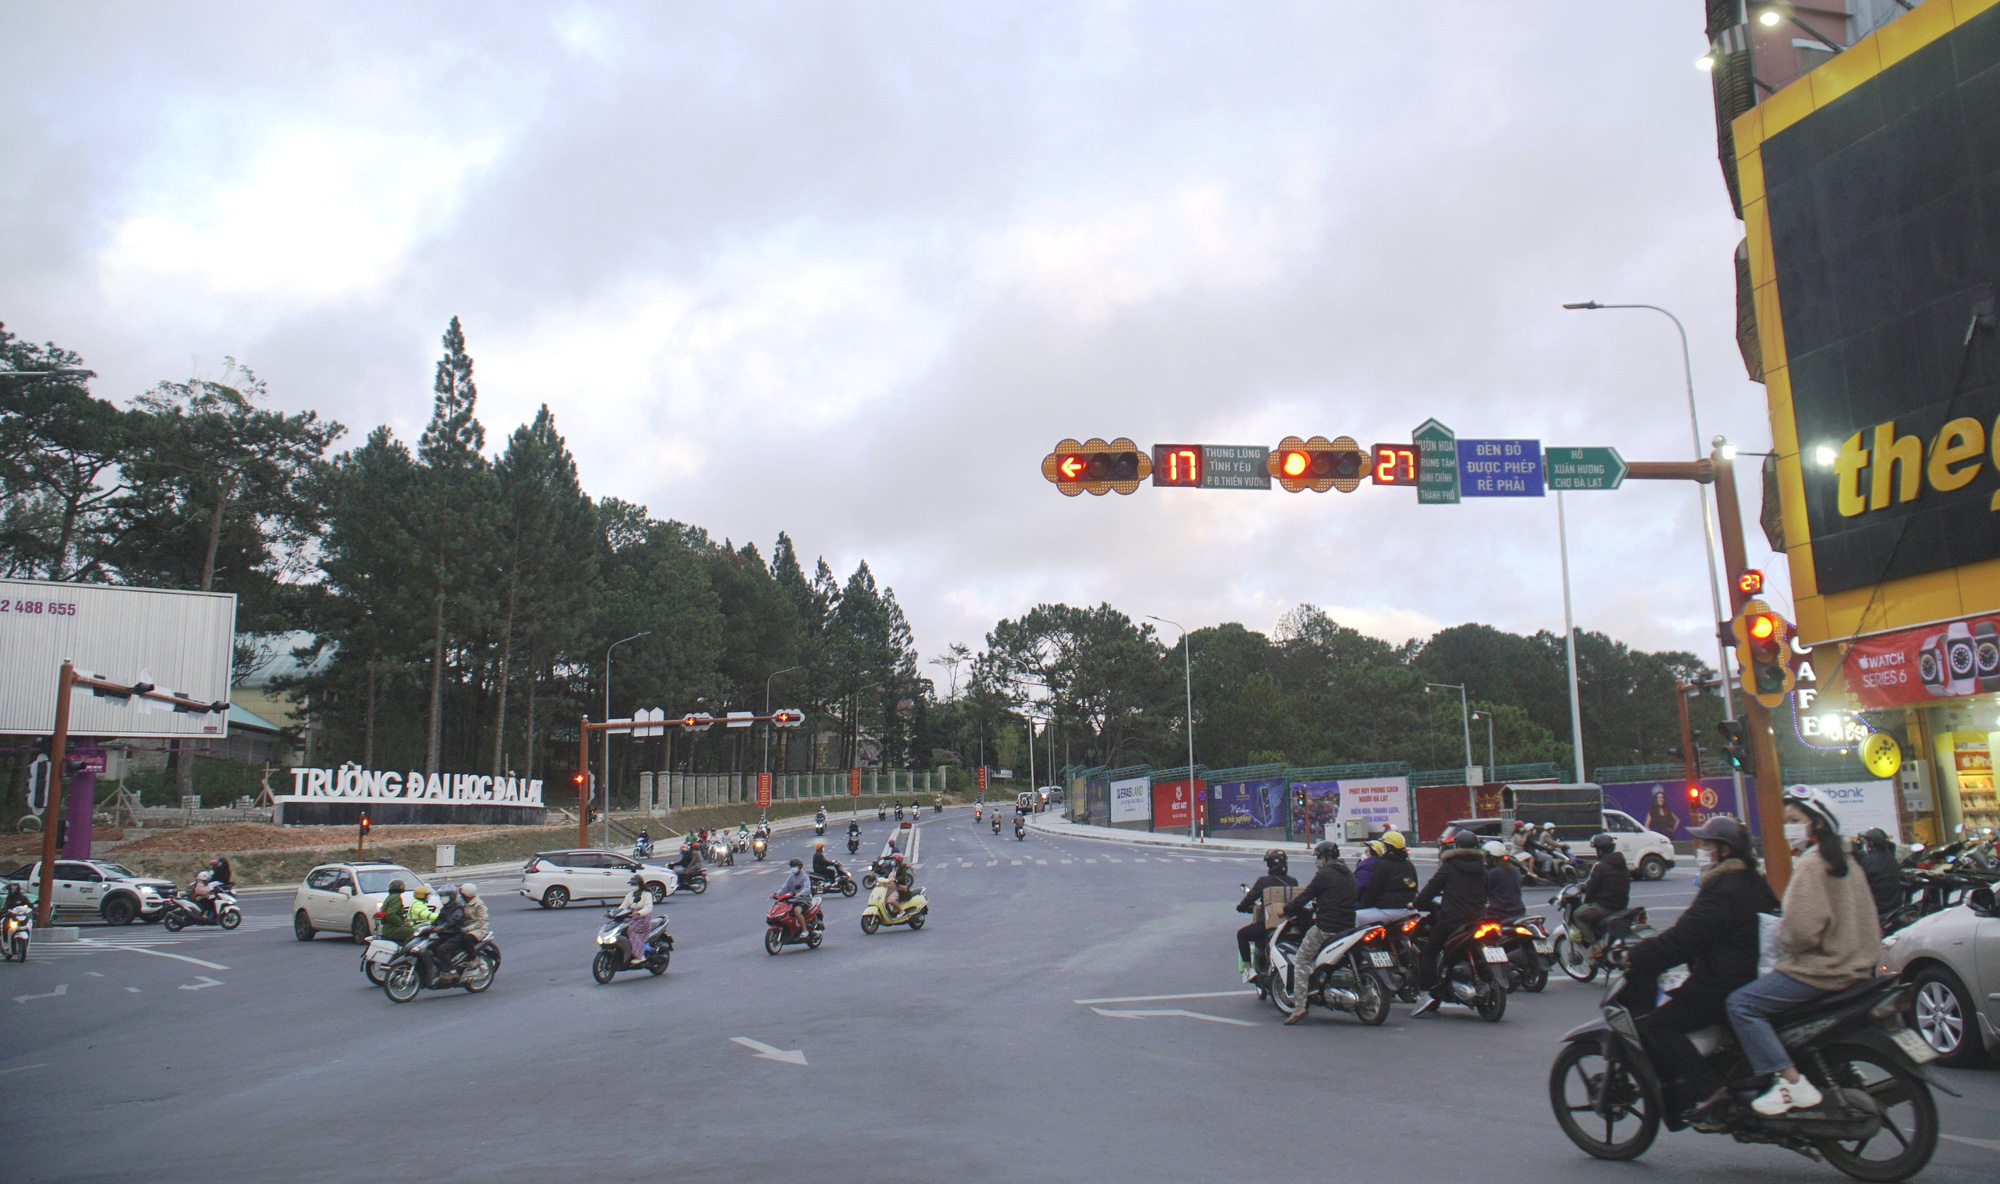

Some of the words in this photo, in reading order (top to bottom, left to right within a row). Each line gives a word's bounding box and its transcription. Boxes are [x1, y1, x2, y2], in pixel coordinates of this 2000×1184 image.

[1205, 448, 1235, 458] THUNG
[1439, 440, 1454, 452] HOA
[1476, 441, 1502, 456] ĐÈN
[1505, 441, 1522, 456] ĐỎ
[1170, 450, 1196, 481] 17
[1210, 459, 1231, 471] TÌNH
[1233, 461, 1251, 472] YÊU
[1378, 449, 1415, 481] 27
[1421, 458, 1440, 468] RUNG
[1442, 457, 1456, 468] TÂM
[1467, 460, 1501, 475] ĐƯỢC
[1504, 458, 1536, 473] PHÉP
[1554, 462, 1576, 474] XUÂN
[1577, 464, 1605, 474] HƯƠNG
[1244, 476, 1270, 487] VƯƠNG
[1497, 475, 1526, 491] PHẢI
[1555, 477, 1572, 489] CHỢ
[1574, 475, 1586, 488] ĐÀ
[1588, 477, 1603, 488] LẠT
[1741, 574, 1760, 590] 27
[15, 600, 43, 614] 488
[48, 602, 76, 616] 655
[1869, 651, 1906, 668] WATCH
[1863, 670, 1898, 688] SERIES
[1899, 669, 1907, 683] 6
[290, 760, 403, 797] TRƯỜNG
